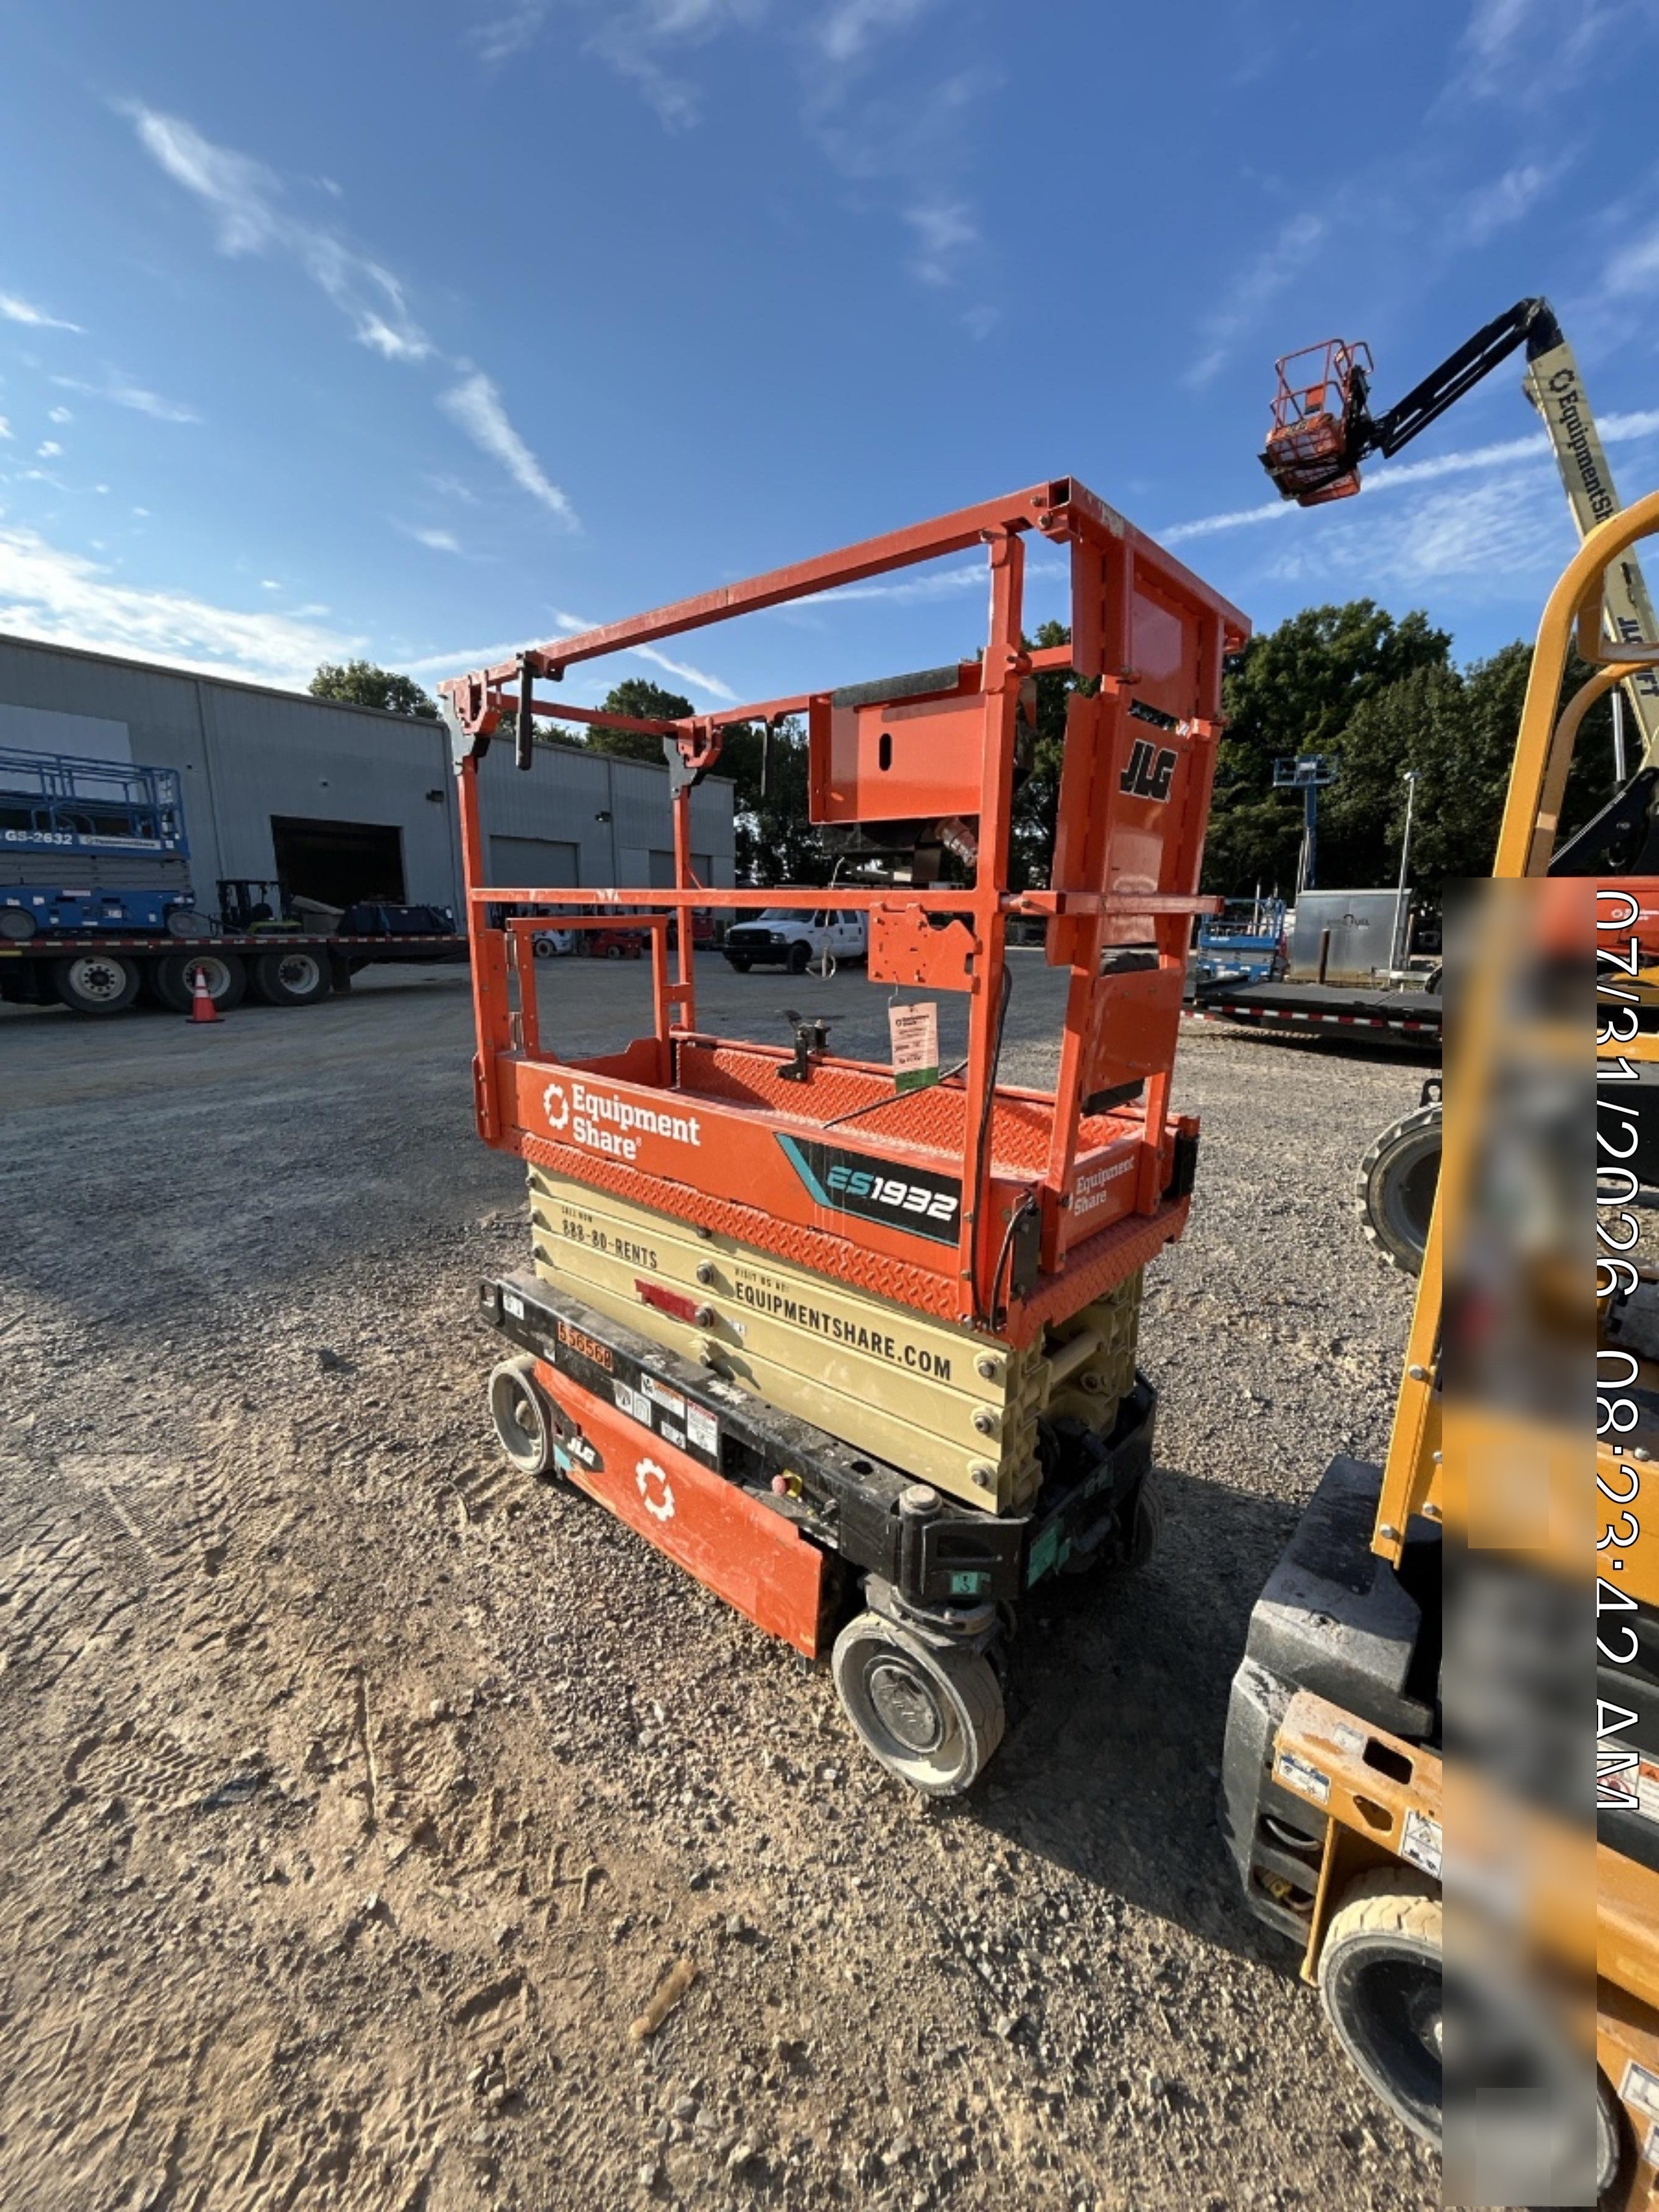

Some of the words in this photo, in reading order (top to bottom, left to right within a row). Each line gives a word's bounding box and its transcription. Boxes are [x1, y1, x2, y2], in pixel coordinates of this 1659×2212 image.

[1558, 390, 1614, 526] EquipmentSh
[1119, 739, 1178, 803] JLG
[571, 1083, 700, 1145] Equipment
[827, 1166, 958, 1222] ES1932
[1074, 1191, 1107, 1215] Share
[1077, 1156, 1135, 1194] Equipment
[735, 1281, 952, 1381] EQUIPMENTSHARE.COM
